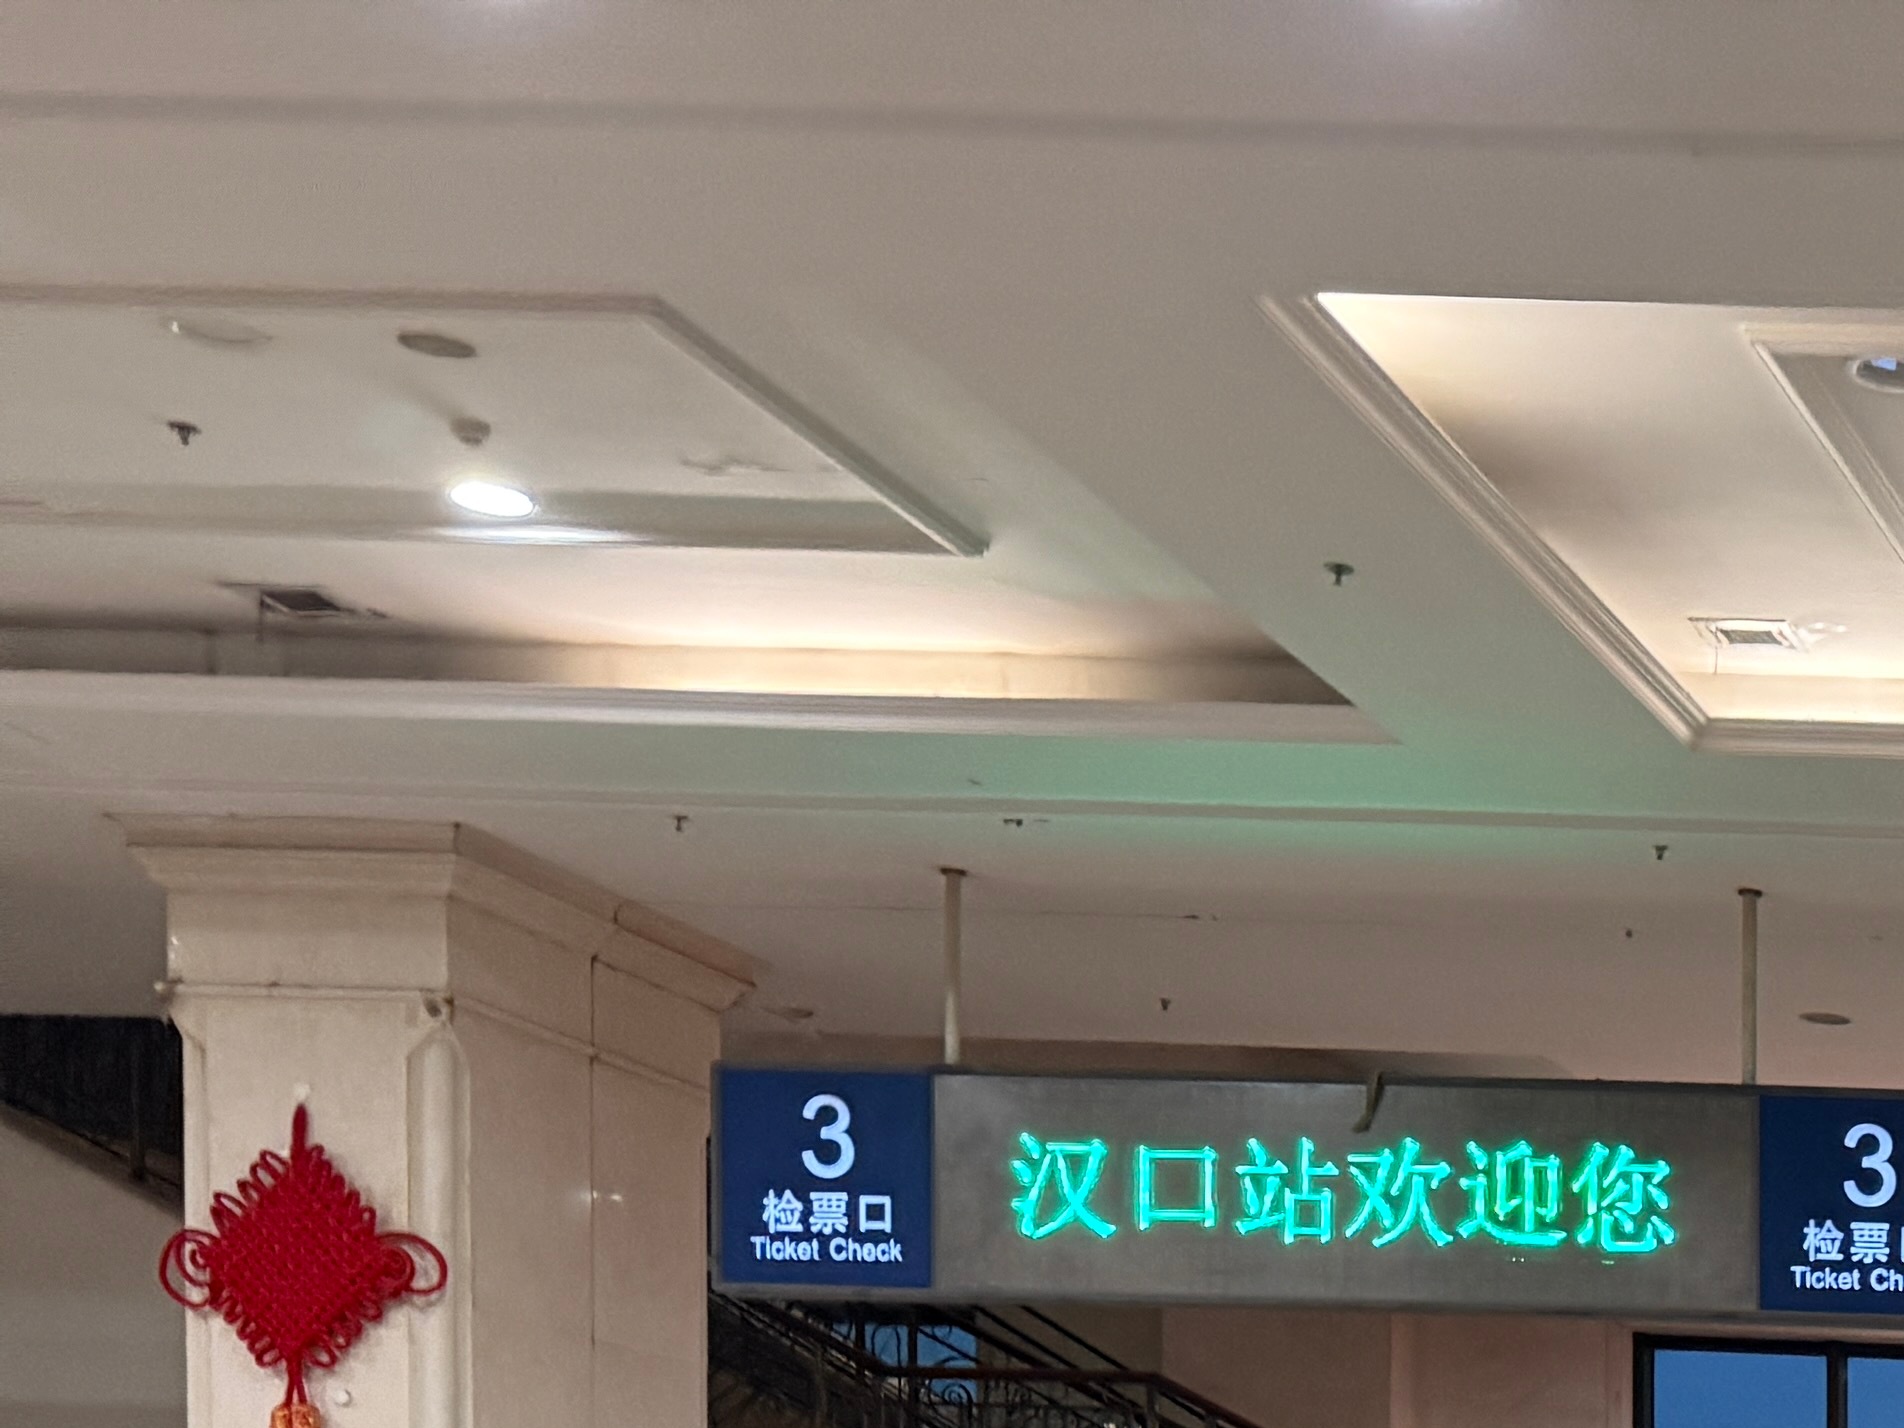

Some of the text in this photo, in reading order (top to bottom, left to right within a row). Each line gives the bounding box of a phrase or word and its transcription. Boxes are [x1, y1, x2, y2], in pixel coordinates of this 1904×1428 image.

[801, 1094, 855, 1179] 3
[1843, 1122, 1897, 1208] 3
[762, 1189, 892, 1235] 检票口
[1010, 1132, 1675, 1254] 汉口站欢迎您
[750, 1236, 903, 1262] Ticket Check
[1790, 1265, 1861, 1290] Ticket
